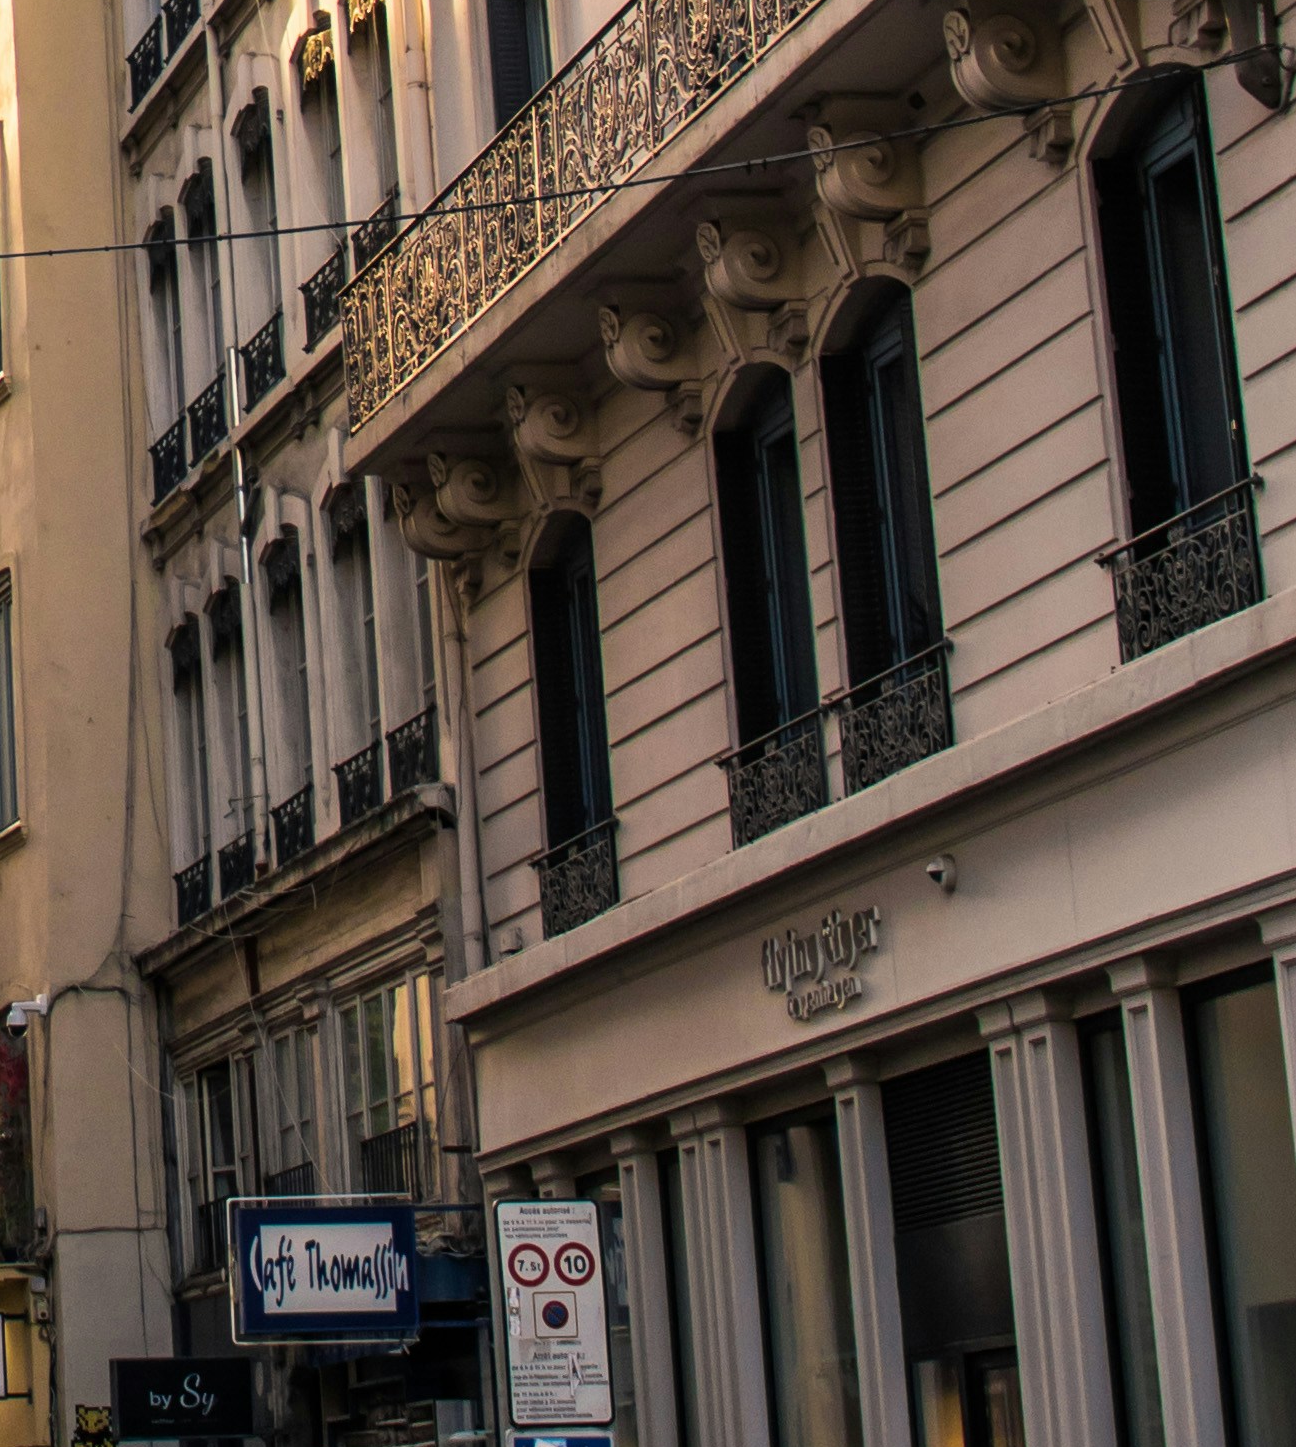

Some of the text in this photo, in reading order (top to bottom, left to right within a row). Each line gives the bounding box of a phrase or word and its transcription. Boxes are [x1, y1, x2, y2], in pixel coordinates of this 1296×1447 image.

[250, 1235, 409, 1307] Café Thomassin
[563, 1255, 587, 1274] 10
[150, 1372, 215, 1416] by Sy
